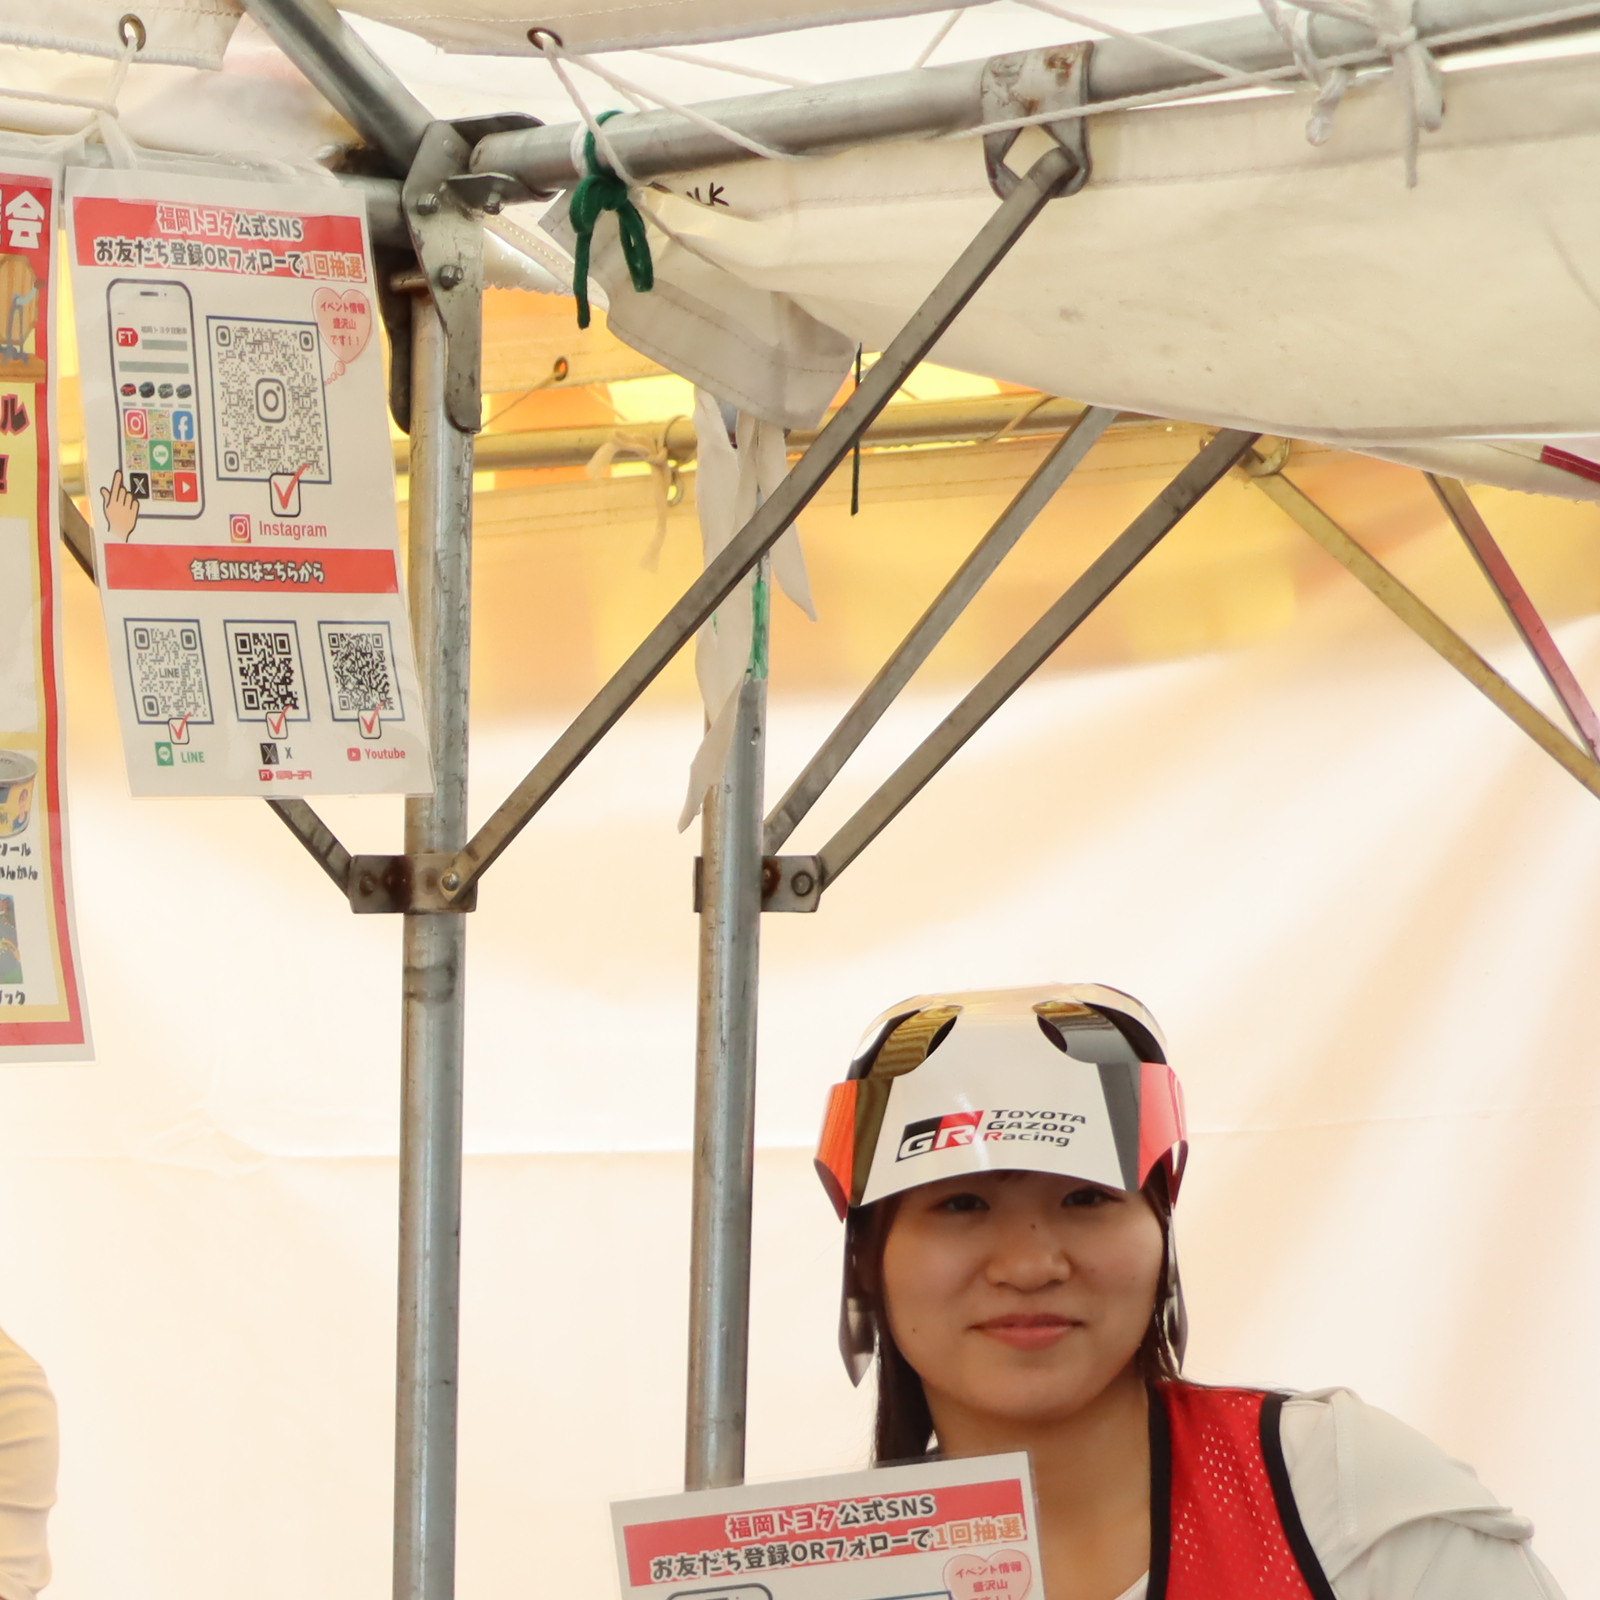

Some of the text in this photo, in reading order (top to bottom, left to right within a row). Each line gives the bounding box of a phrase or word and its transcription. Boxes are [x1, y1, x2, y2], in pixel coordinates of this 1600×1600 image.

[156, 205, 303, 243] 福岡トヨタ公式SNS
[94, 237, 365, 280] お友だち登録ORフォローで1回抽選
[320, 301, 366, 315] イベント情報
[117, 330, 134, 344] FT
[258, 520, 328, 540] Instagram
[189, 558, 326, 584] 各種SNSはこちらから
[158, 666, 181, 680] LINE
[180, 751, 206, 765] LINE
[284, 746, 293, 760] X
[364, 747, 407, 761] Youtube
[991, 1109, 1087, 1125] TOYOTA
[986, 1120, 1076, 1135] GAZOO
[897, 1116, 982, 1162] GR
[982, 1131, 1071, 1148] Racing
[725, 1495, 936, 1540] 福岡トヨタ公式SNS
[651, 1516, 1024, 1582] お友だち登録ORフォローで1回抽選
[954, 1560, 1024, 1580] イベント情報
[972, 1577, 1009, 1593] 盛沢山
